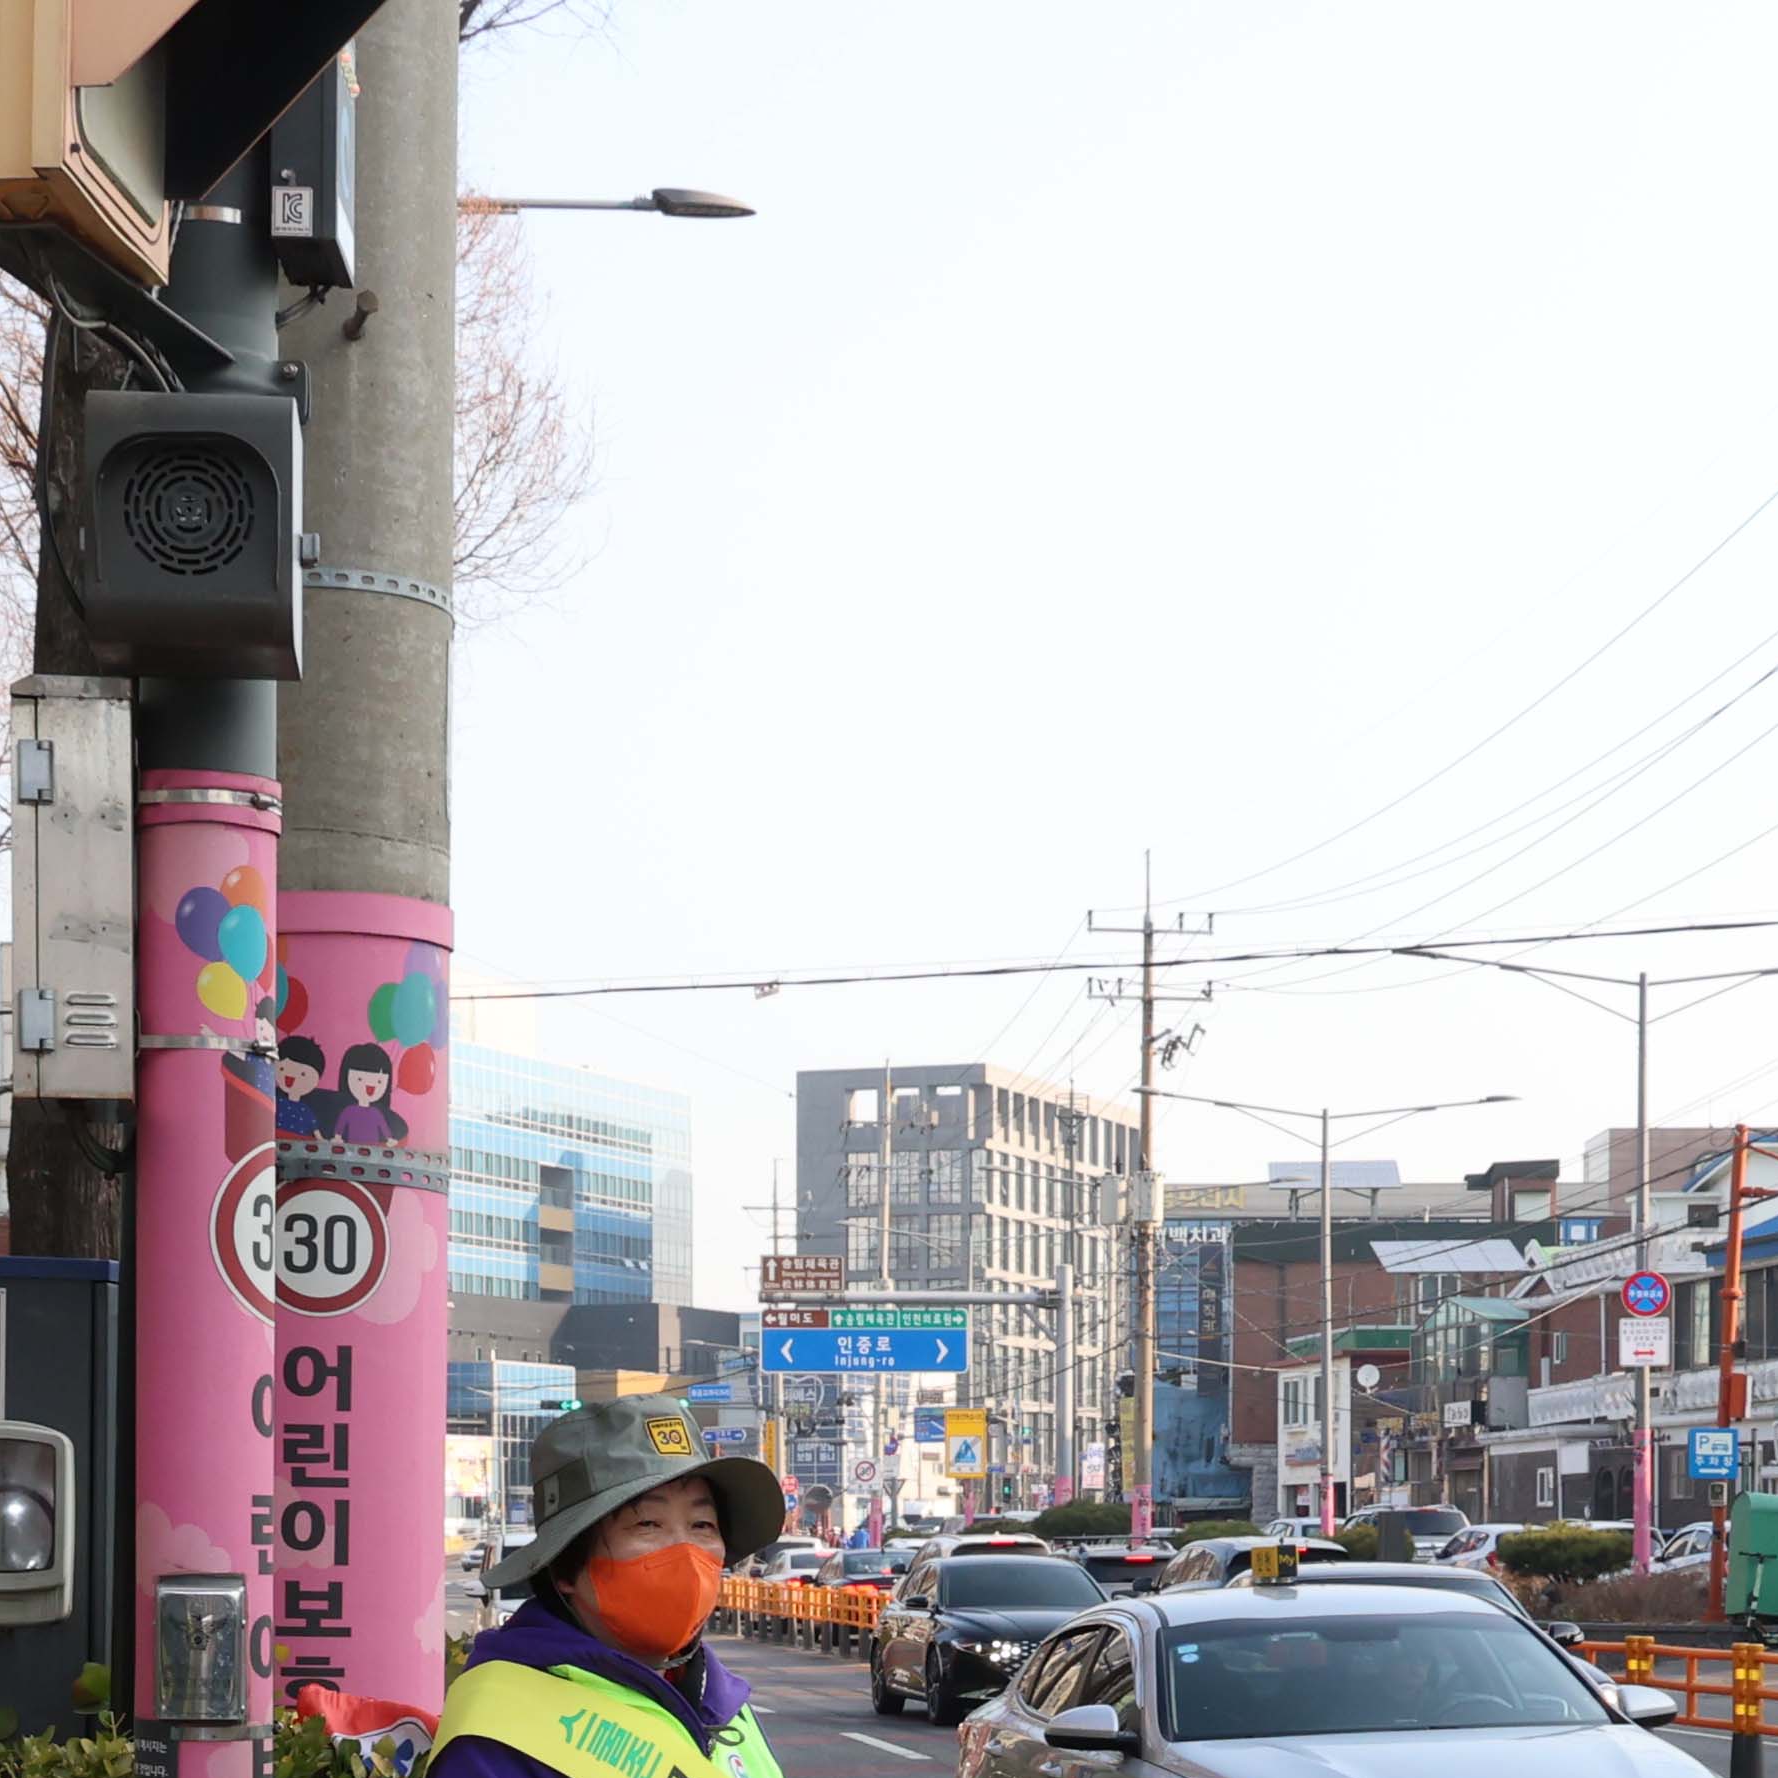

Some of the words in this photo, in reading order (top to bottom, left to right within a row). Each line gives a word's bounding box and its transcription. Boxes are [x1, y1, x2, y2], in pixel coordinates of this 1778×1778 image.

[283, 1213, 357, 1275] 30
[777, 1313, 814, 1326] 월미도
[837, 1336, 892, 1354] 인중로
[835, 1355, 896, 1368] Injung-ro
[657, 1429, 682, 1445] 30
[1699, 1434, 1710, 1450] P
[1695, 1455, 1734, 1466] 주차장
